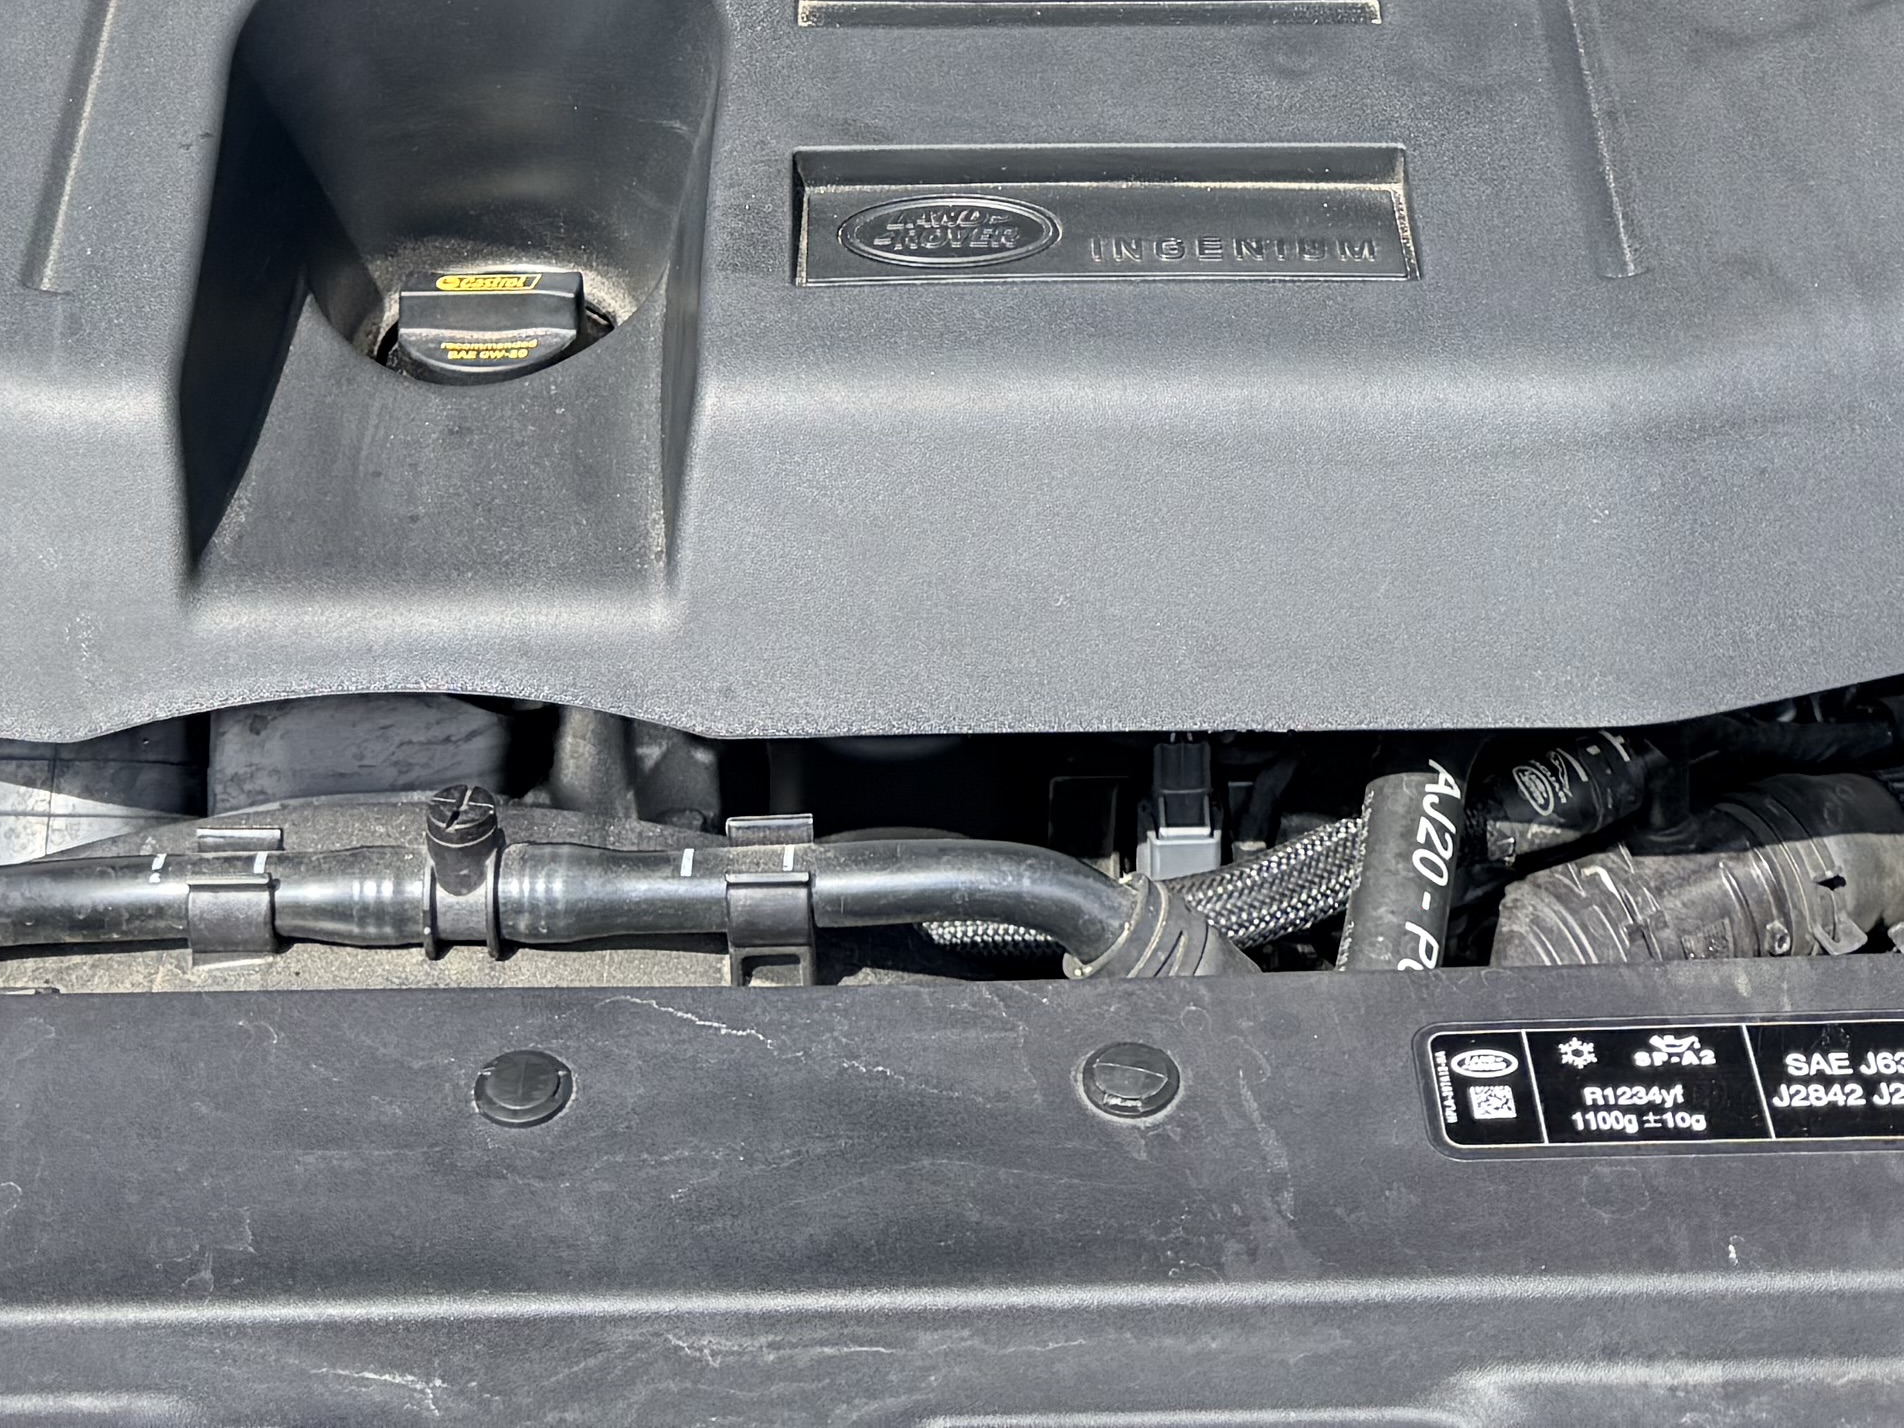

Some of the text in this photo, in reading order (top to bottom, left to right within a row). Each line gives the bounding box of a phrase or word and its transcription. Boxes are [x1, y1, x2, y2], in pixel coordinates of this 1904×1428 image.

[895, 226, 1021, 251] ROVER
[1089, 235, 1379, 263] INGENIUM
[440, 338, 538, 350] recommended
[447, 350, 478, 360] SAE
[1633, 1049, 1717, 1067] SP-A2
[1785, 1052, 1853, 1076] SAE
[1583, 1084, 1685, 1108] R1234yf
[1772, 1082, 1866, 1107] J2842
[1571, 1111, 1707, 1134] 1100g ±10g
